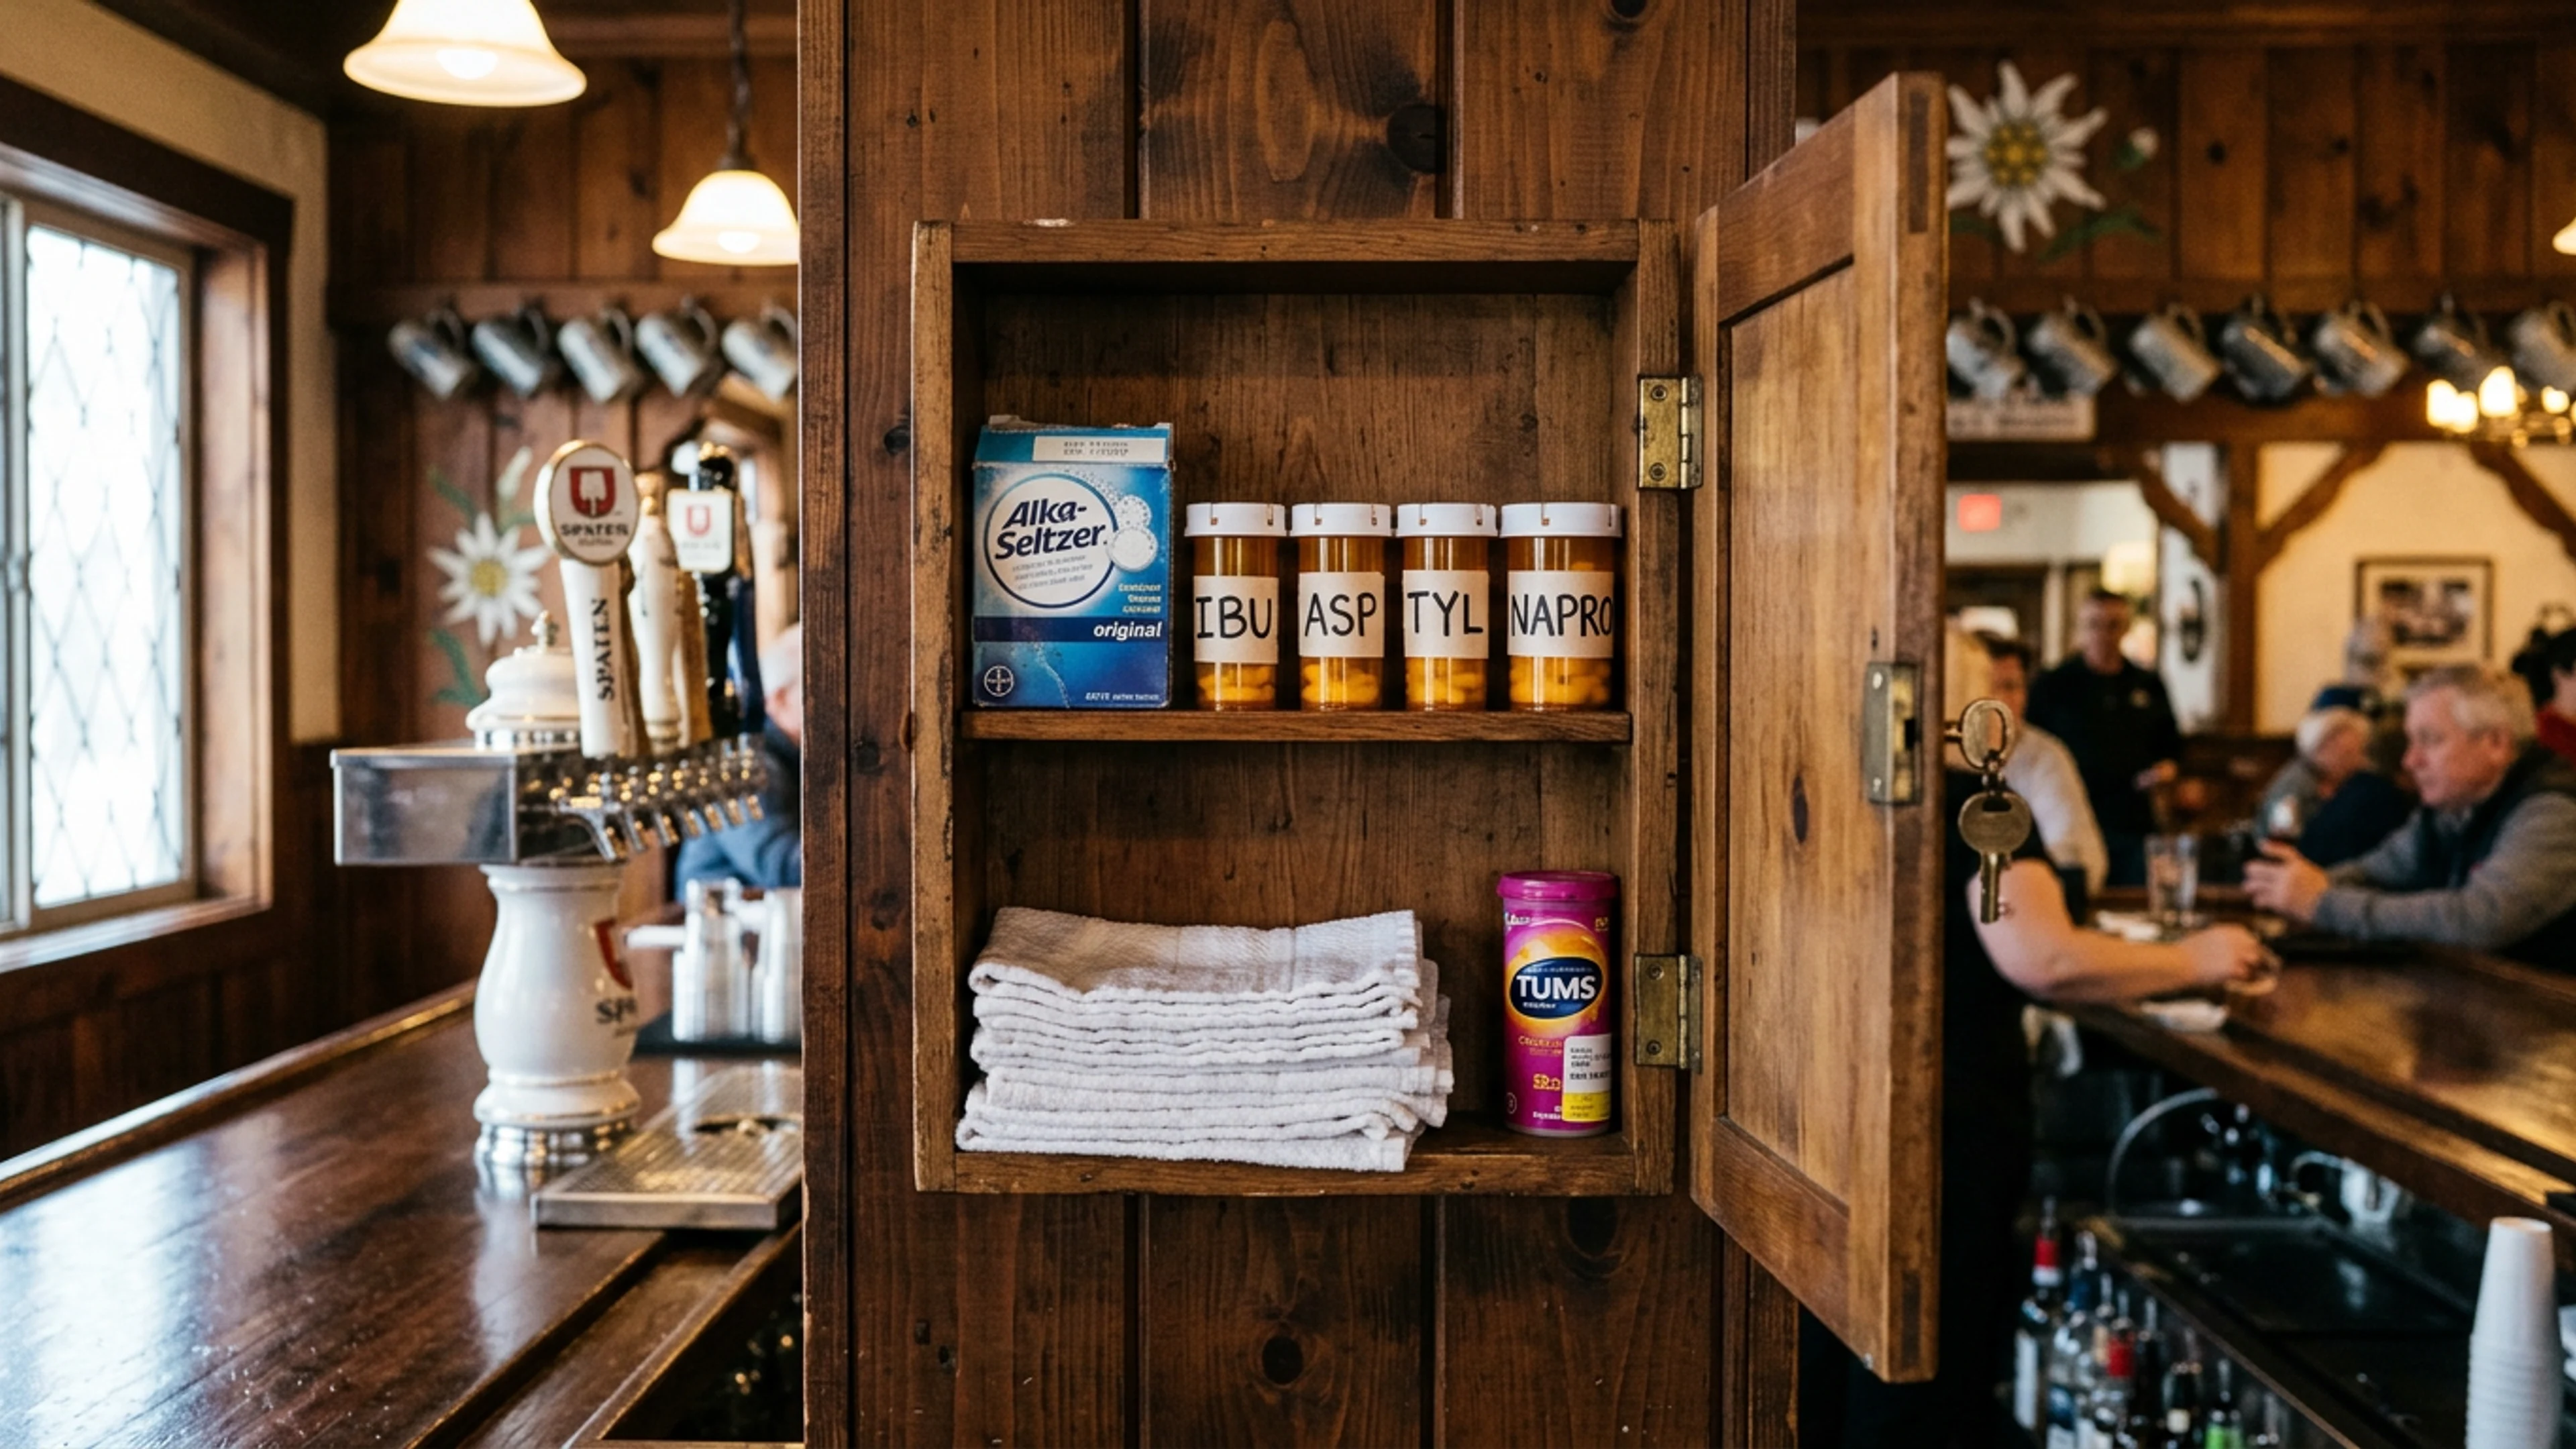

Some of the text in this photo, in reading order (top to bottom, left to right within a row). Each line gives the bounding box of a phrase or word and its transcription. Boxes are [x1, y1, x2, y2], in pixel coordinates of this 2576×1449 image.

[1002, 498, 1087, 530] Alka-
[994, 524, 1106, 560] Seltzer
[1093, 621, 1163, 641] original
[1195, 596, 1272, 639] IBU
[1305, 592, 1377, 637] ASP
[1407, 590, 1484, 637] TYL
[1511, 593, 1613, 637] NAPRO
[1516, 975, 1597, 1000] TUMS
